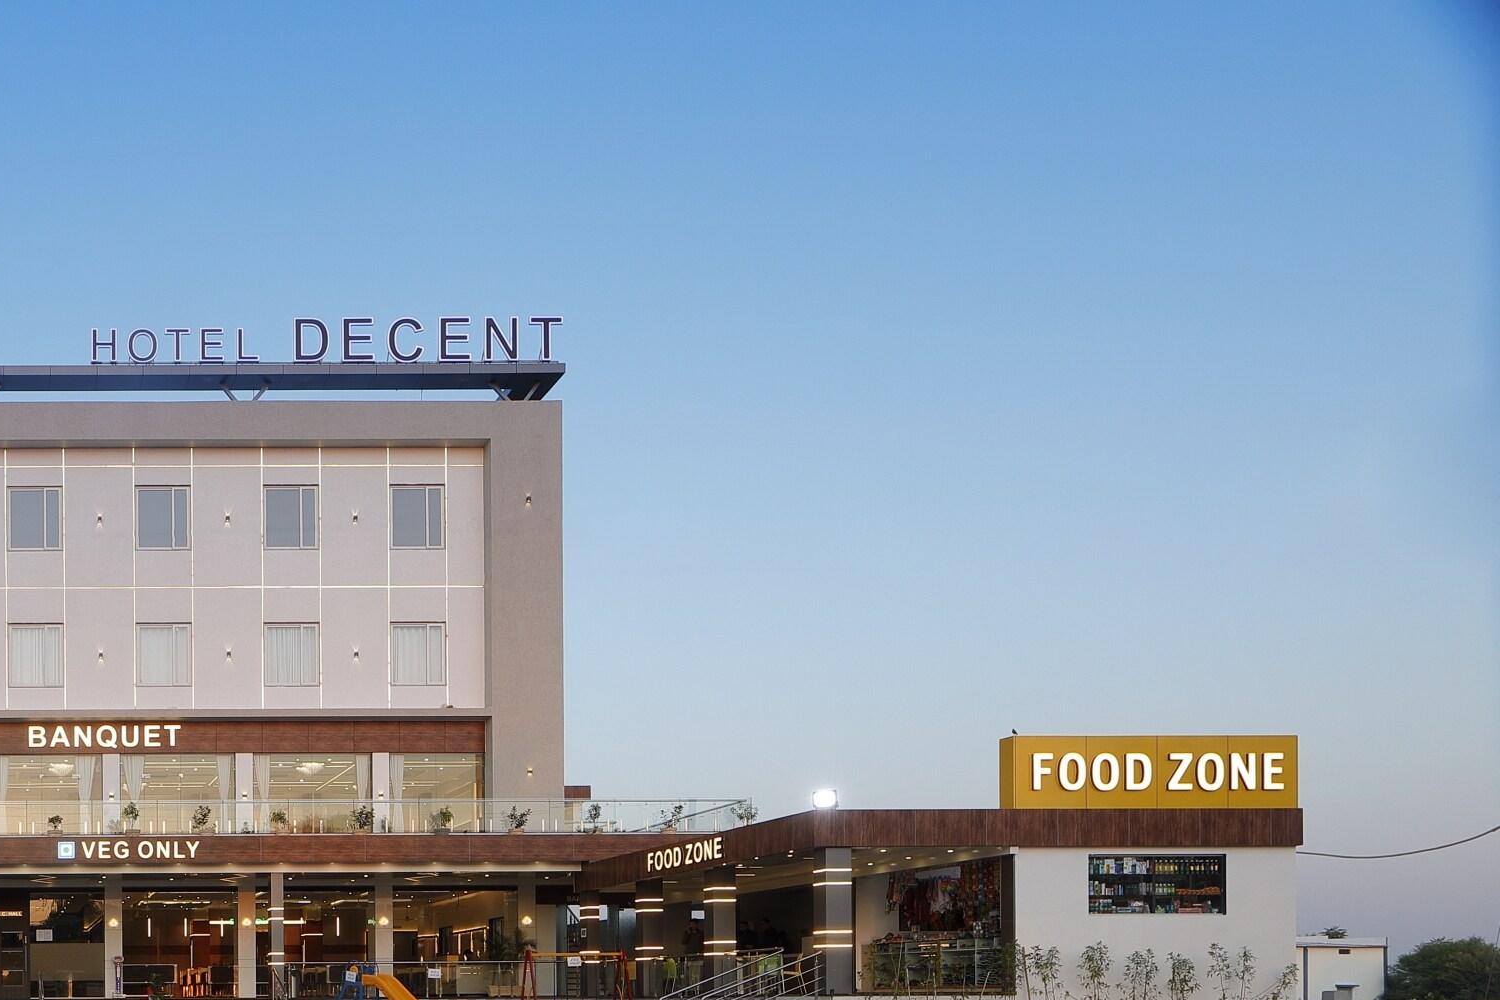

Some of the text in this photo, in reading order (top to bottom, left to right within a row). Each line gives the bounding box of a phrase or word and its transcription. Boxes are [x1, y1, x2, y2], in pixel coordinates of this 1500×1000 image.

[91, 316, 564, 363] HOTEL DECENT
[28, 725, 181, 748] BANQUET
[1032, 752, 1285, 791] FOOD ZONE
[81, 840, 200, 859] VEG ONLY
[647, 836, 722, 873] FOOD ZONE
